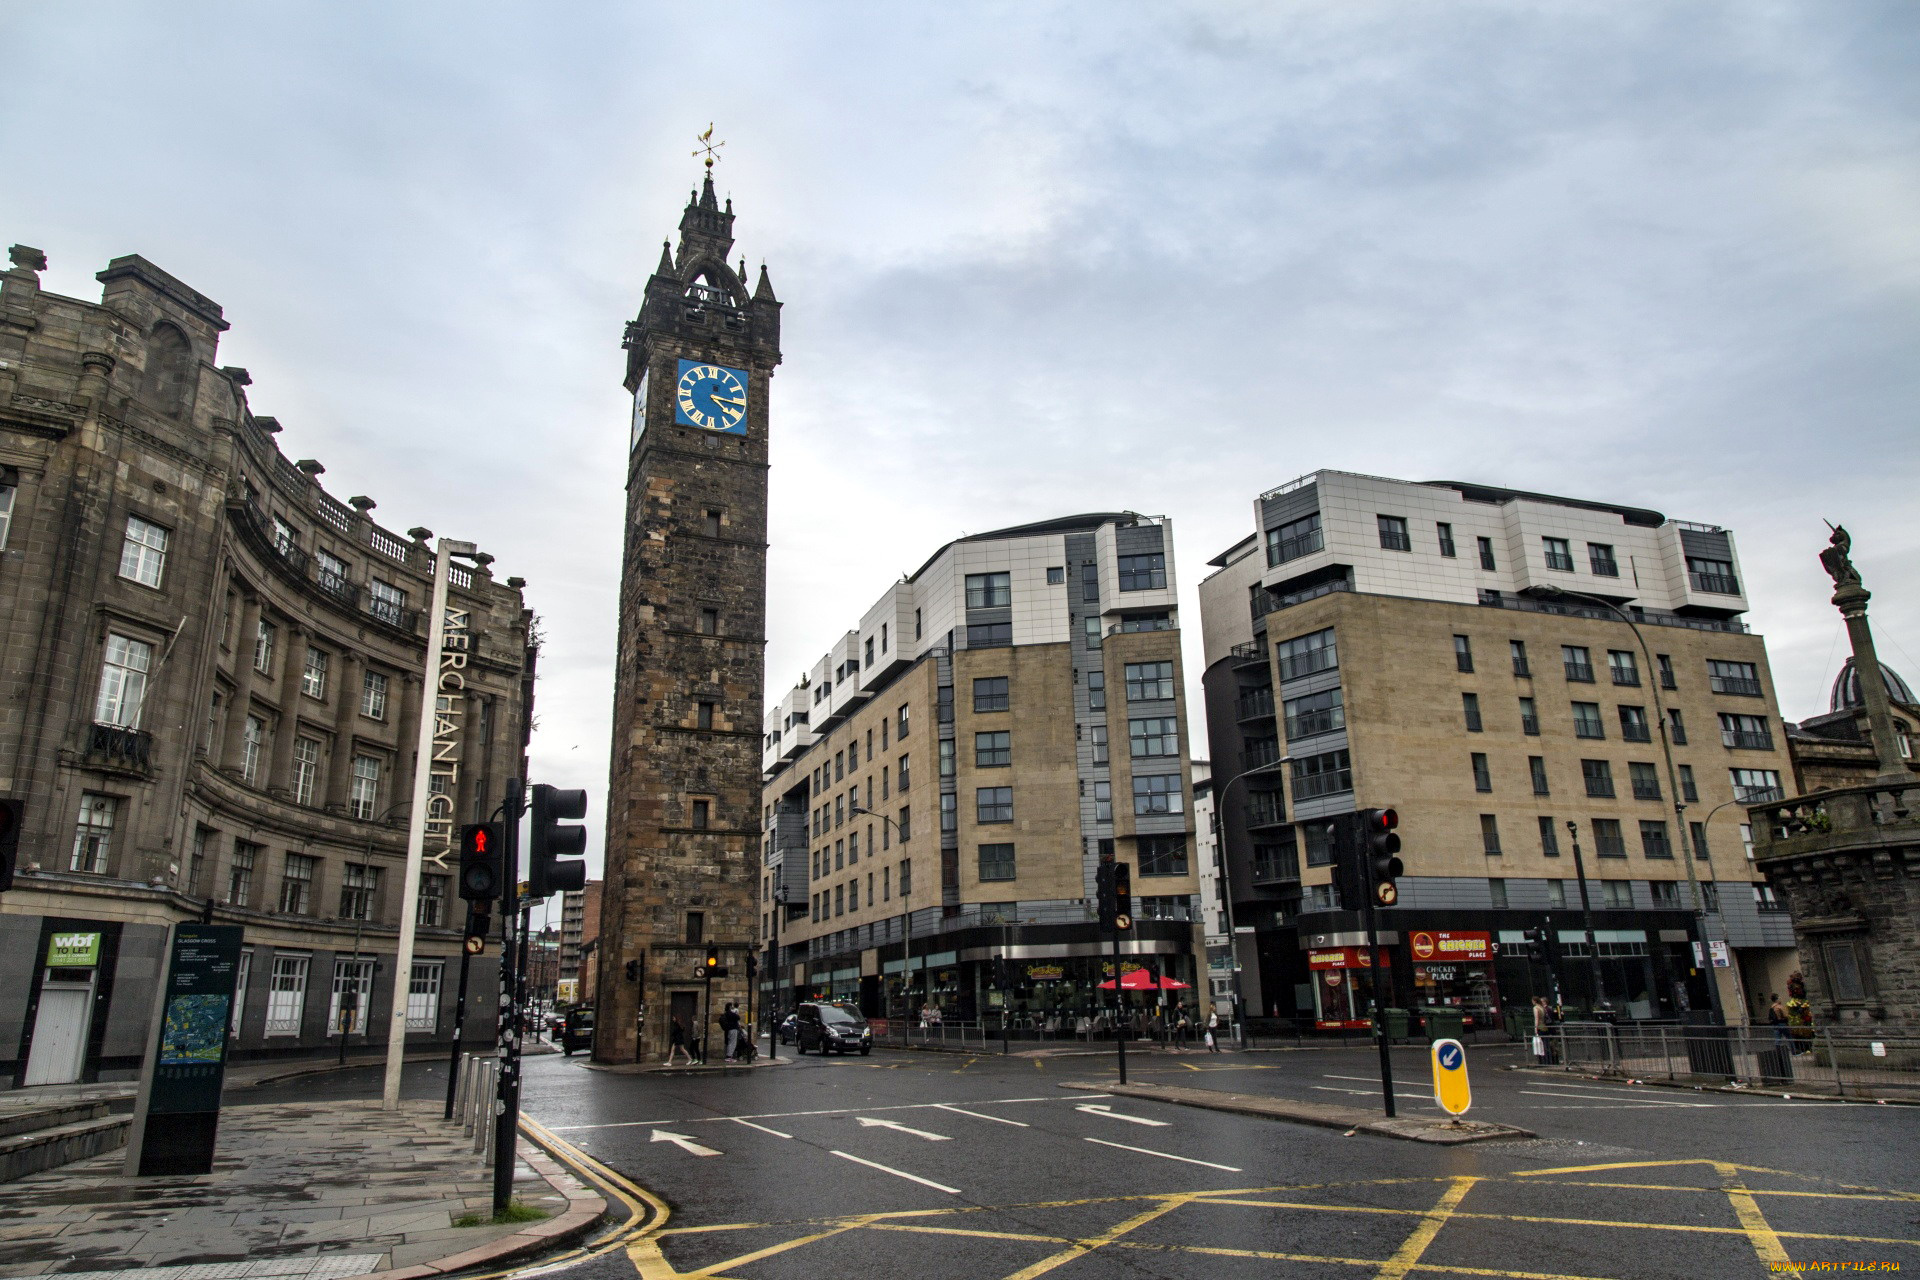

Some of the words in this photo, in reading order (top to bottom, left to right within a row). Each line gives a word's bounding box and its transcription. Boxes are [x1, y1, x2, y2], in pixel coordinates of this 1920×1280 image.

[430, 605, 470, 784] MERCHANT
[421, 794, 454, 870] CITY
[55, 934, 96, 947] wbf
[1438, 940, 1487, 951] CHICKEN
[1310, 953, 1345, 963] CHICKEN
